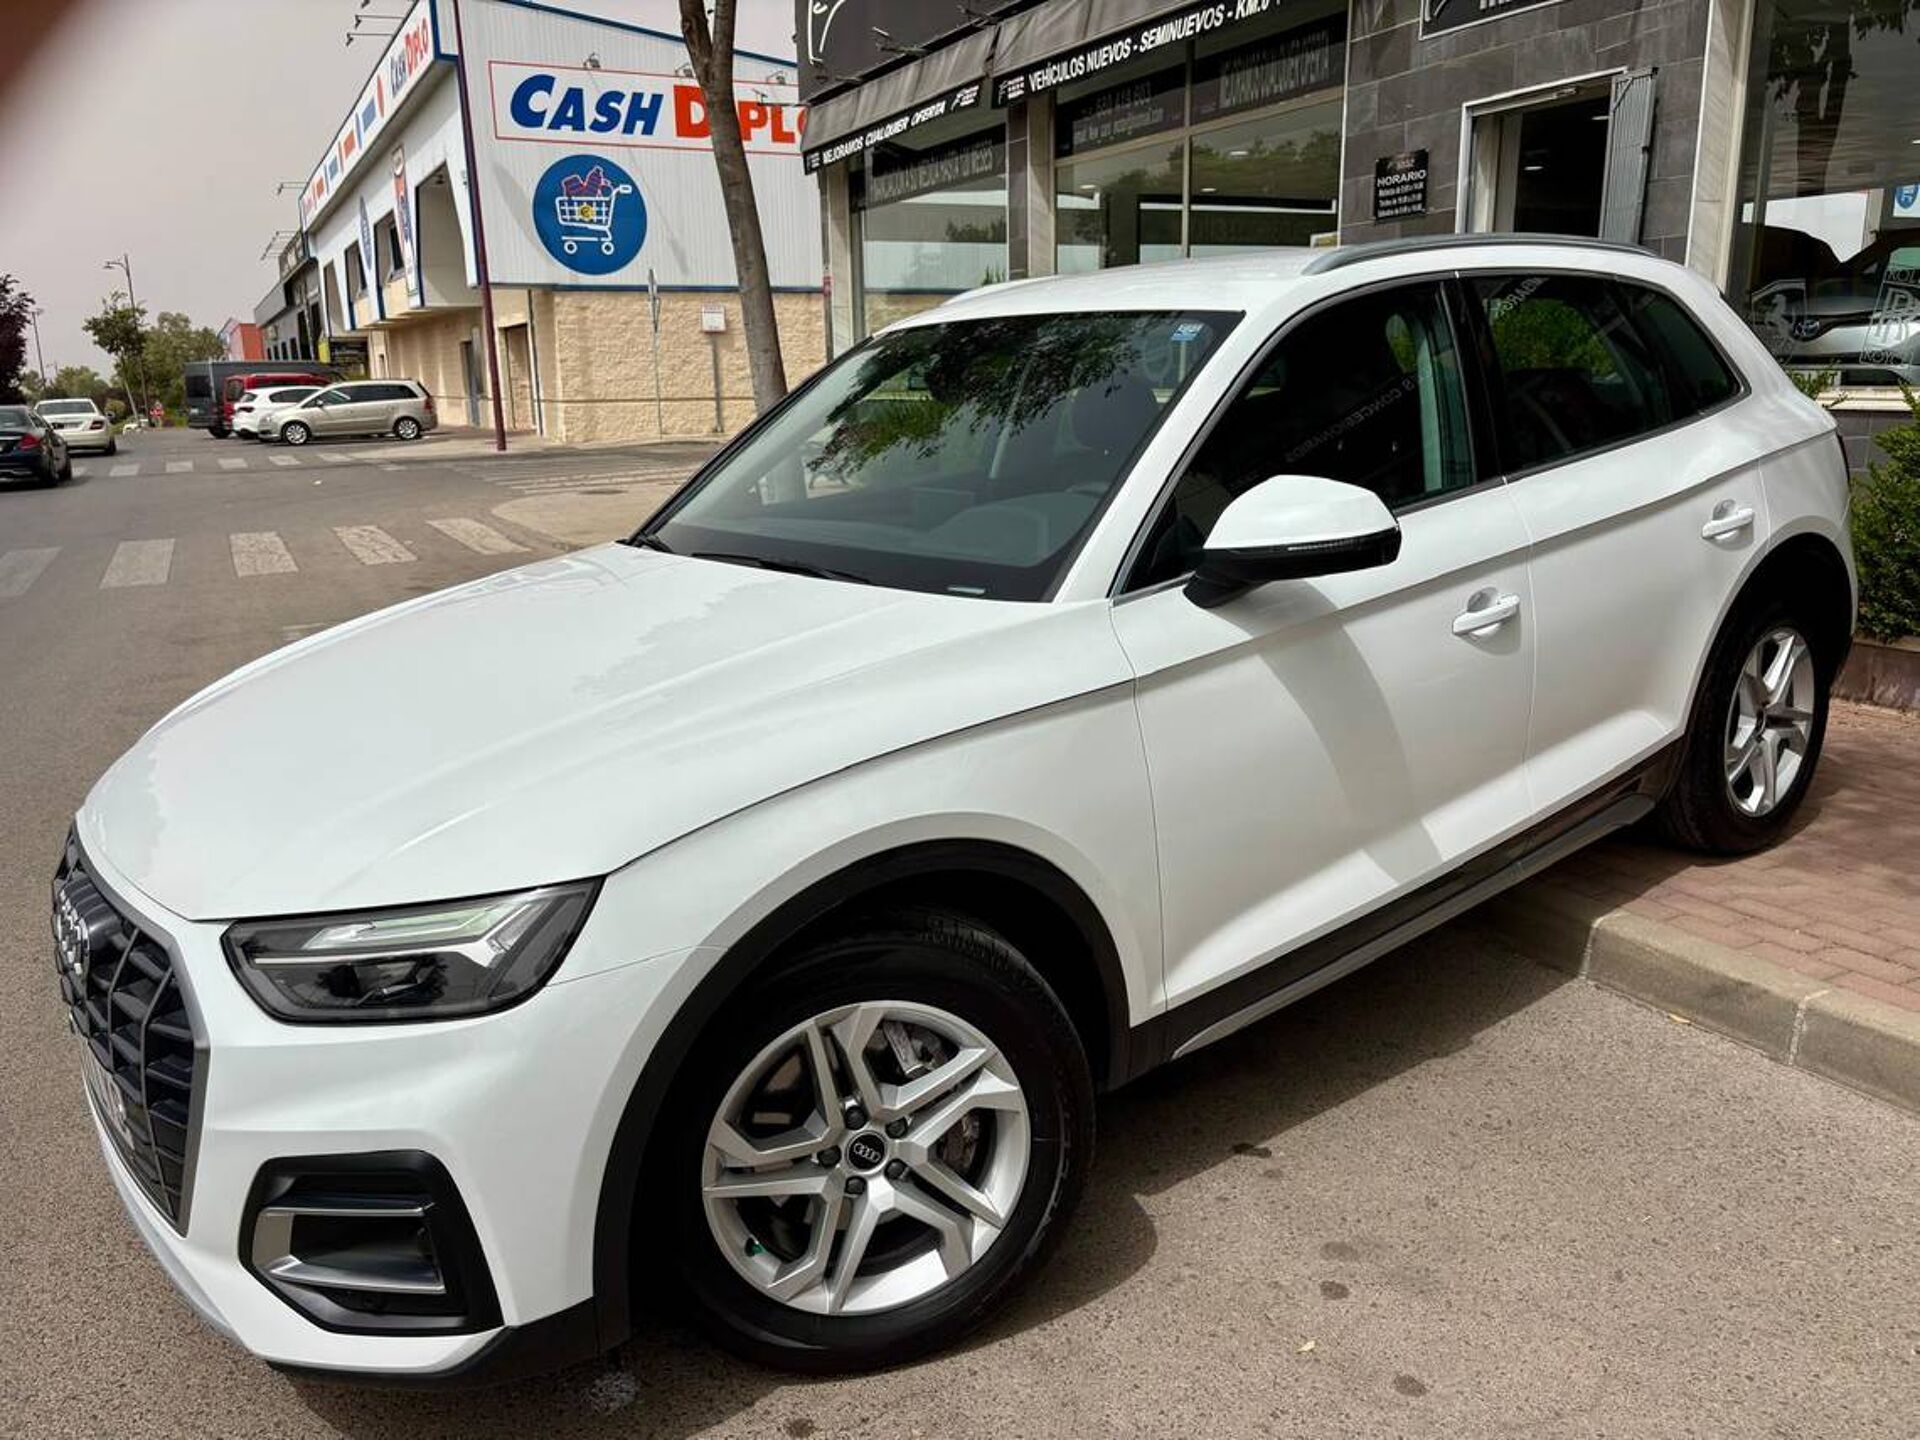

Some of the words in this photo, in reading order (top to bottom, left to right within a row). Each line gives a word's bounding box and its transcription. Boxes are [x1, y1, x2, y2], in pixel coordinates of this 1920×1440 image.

[1028, 55, 1085, 92] VEHÍCULOS
[1086, 37, 1132, 72] NUEVOS
[1139, 4, 1225, 53] SEMINUEVOS
[510, 73, 664, 136] CASH
[673, 84, 810, 143] DPL
[822, 136, 864, 166] MEJORAMOS
[865, 116, 910, 147] CUALQUIER
[910, 100, 947, 127] OFERTA
[1377, 169, 1427, 187] HORARIO
